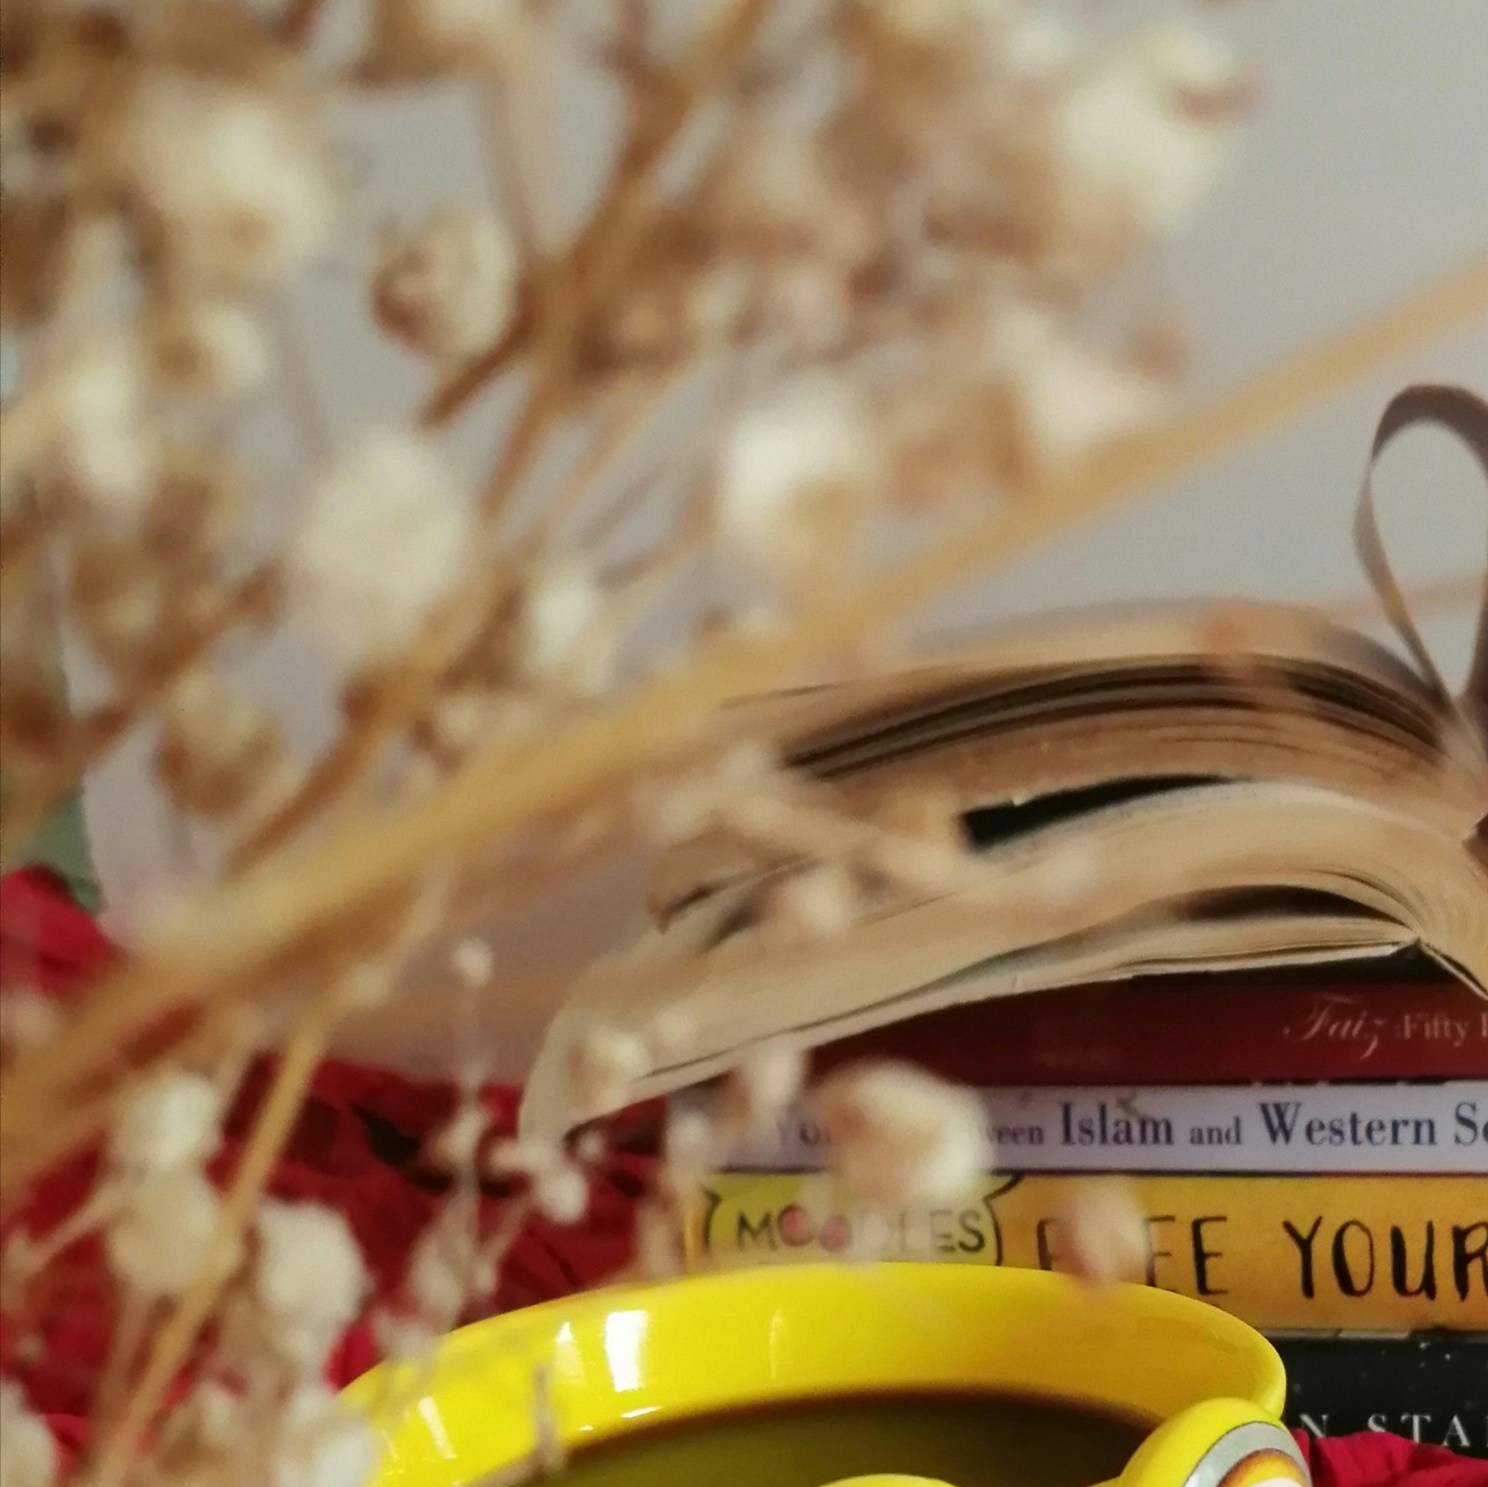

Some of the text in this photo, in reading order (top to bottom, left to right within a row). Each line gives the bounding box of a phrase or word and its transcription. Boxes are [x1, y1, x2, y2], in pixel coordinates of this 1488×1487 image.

[1061, 1101, 1175, 1146] Islam
[1189, 1116, 1243, 1146] and
[1258, 1102, 1438, 1147] Western
[735, 1204, 986, 1254] MOOLES
[1036, 1215, 1229, 1296] FEE
